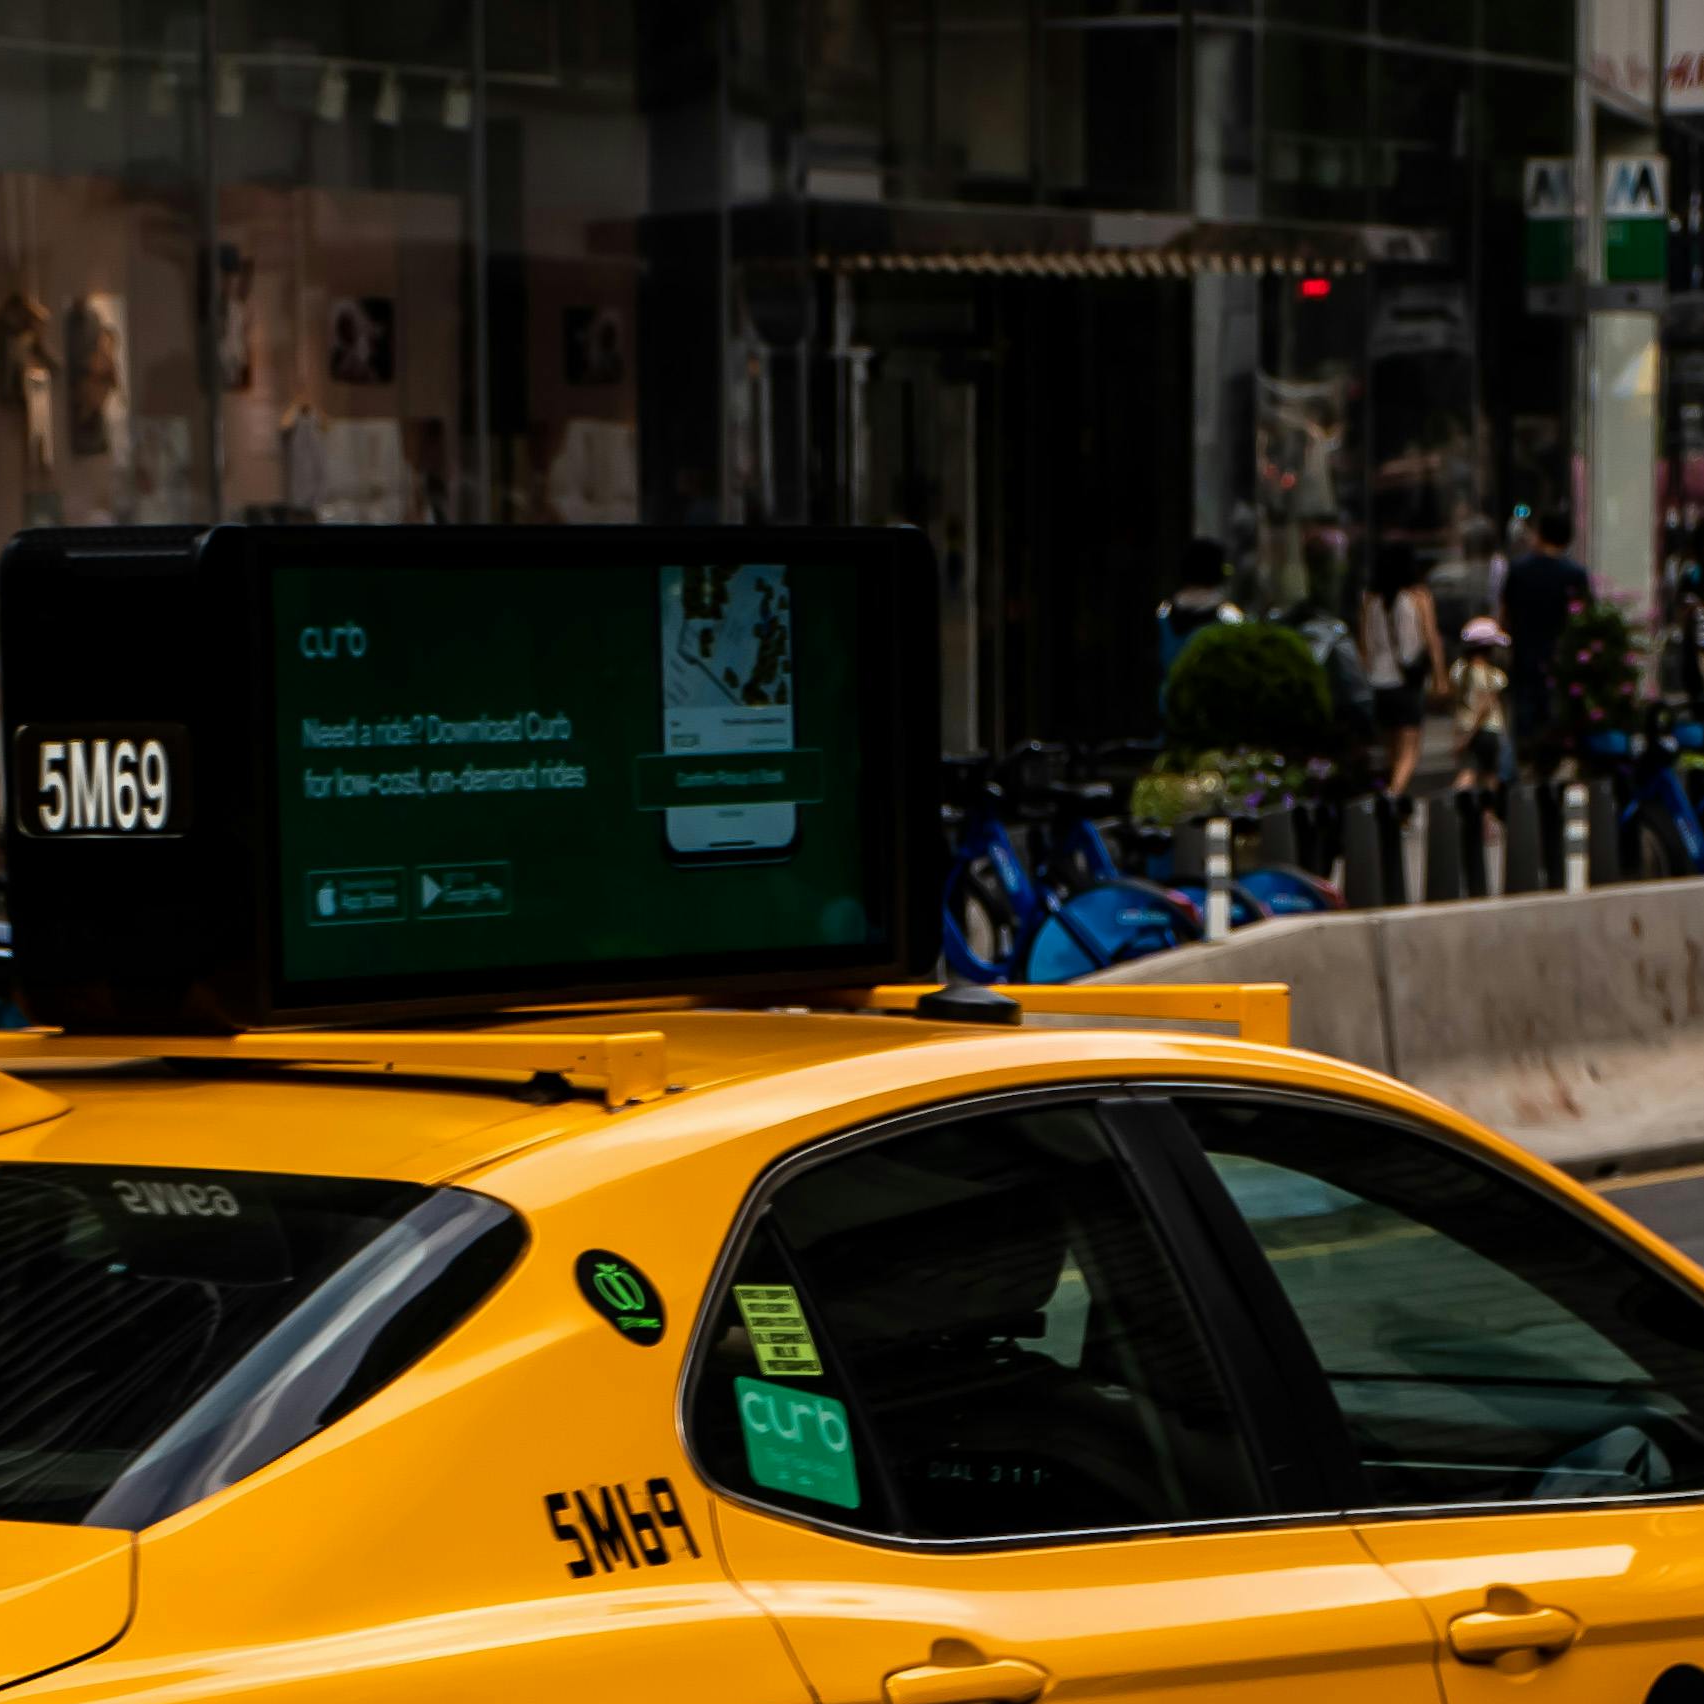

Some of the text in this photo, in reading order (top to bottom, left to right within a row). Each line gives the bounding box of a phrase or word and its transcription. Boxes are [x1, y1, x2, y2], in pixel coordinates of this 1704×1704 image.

[299, 620, 368, 659] curb
[38, 738, 170, 832] 5M69
[742, 1391, 848, 1453] curb
[544, 1477, 702, 1579] 5M69
